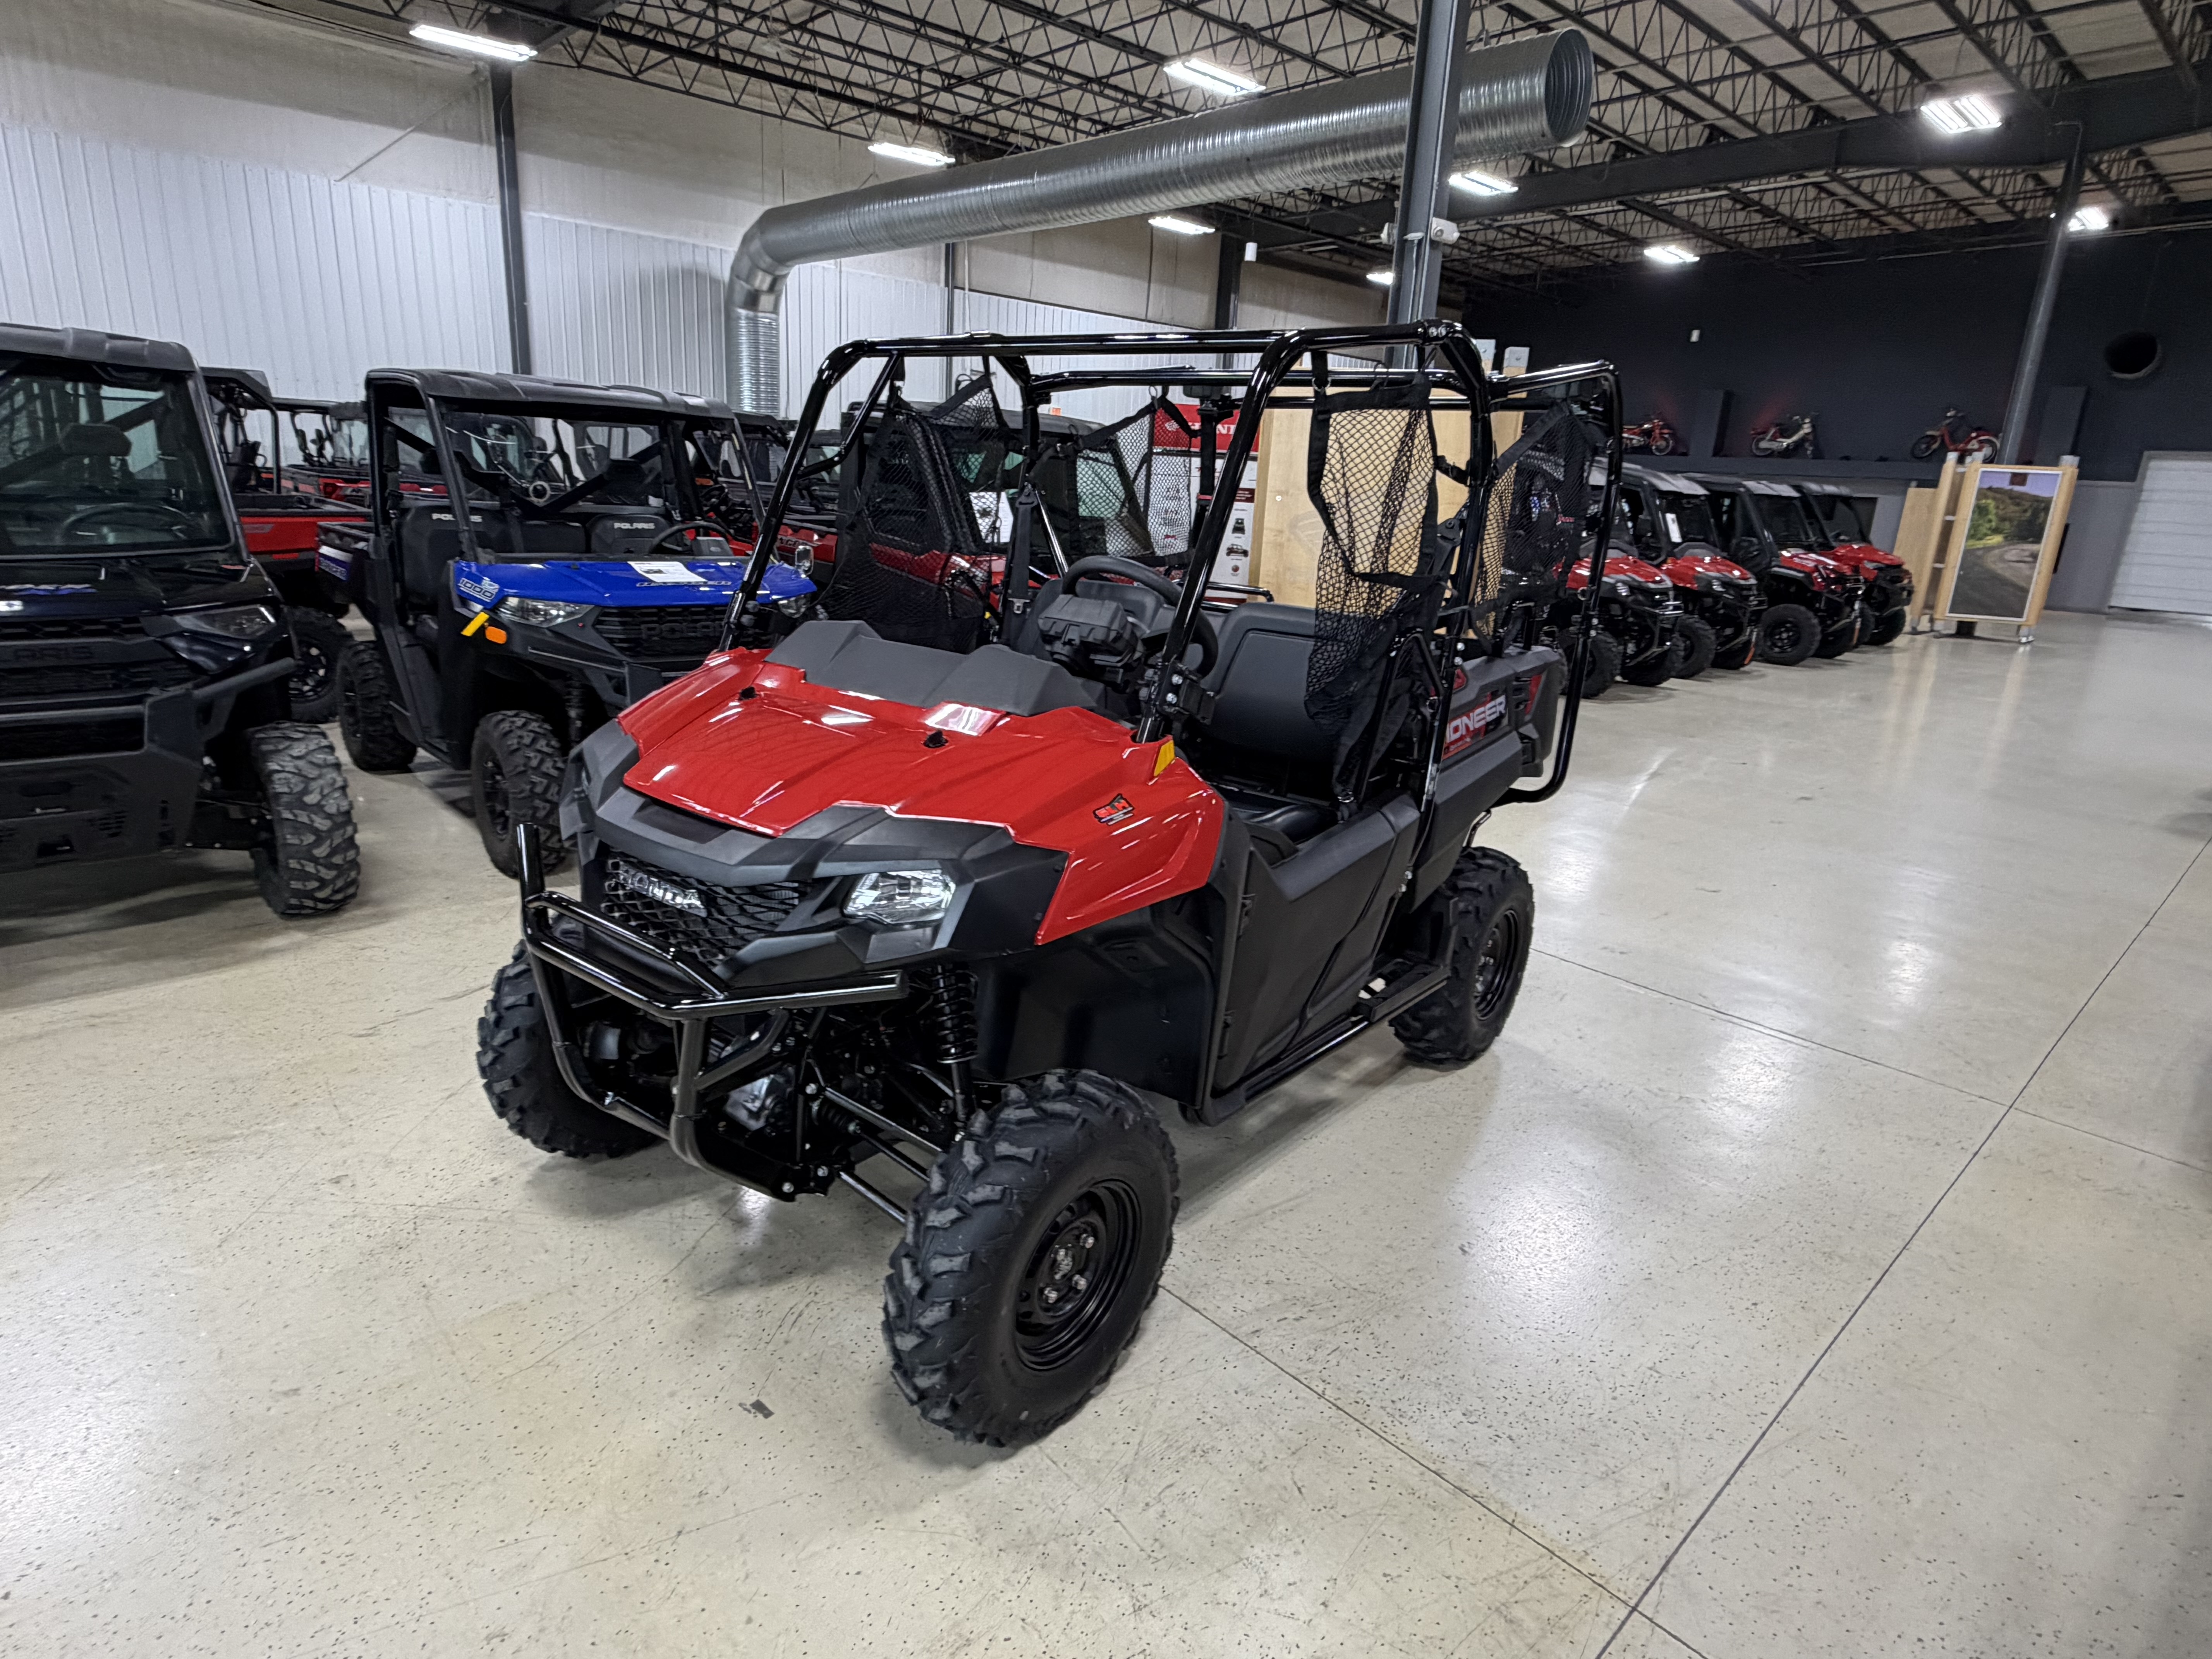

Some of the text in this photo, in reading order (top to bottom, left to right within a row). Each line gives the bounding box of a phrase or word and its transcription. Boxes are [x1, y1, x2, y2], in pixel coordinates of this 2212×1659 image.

[431, 513, 483, 522] POLIS
[460, 579, 496, 599] 1000
[1445, 694, 1506, 743] IONEER
